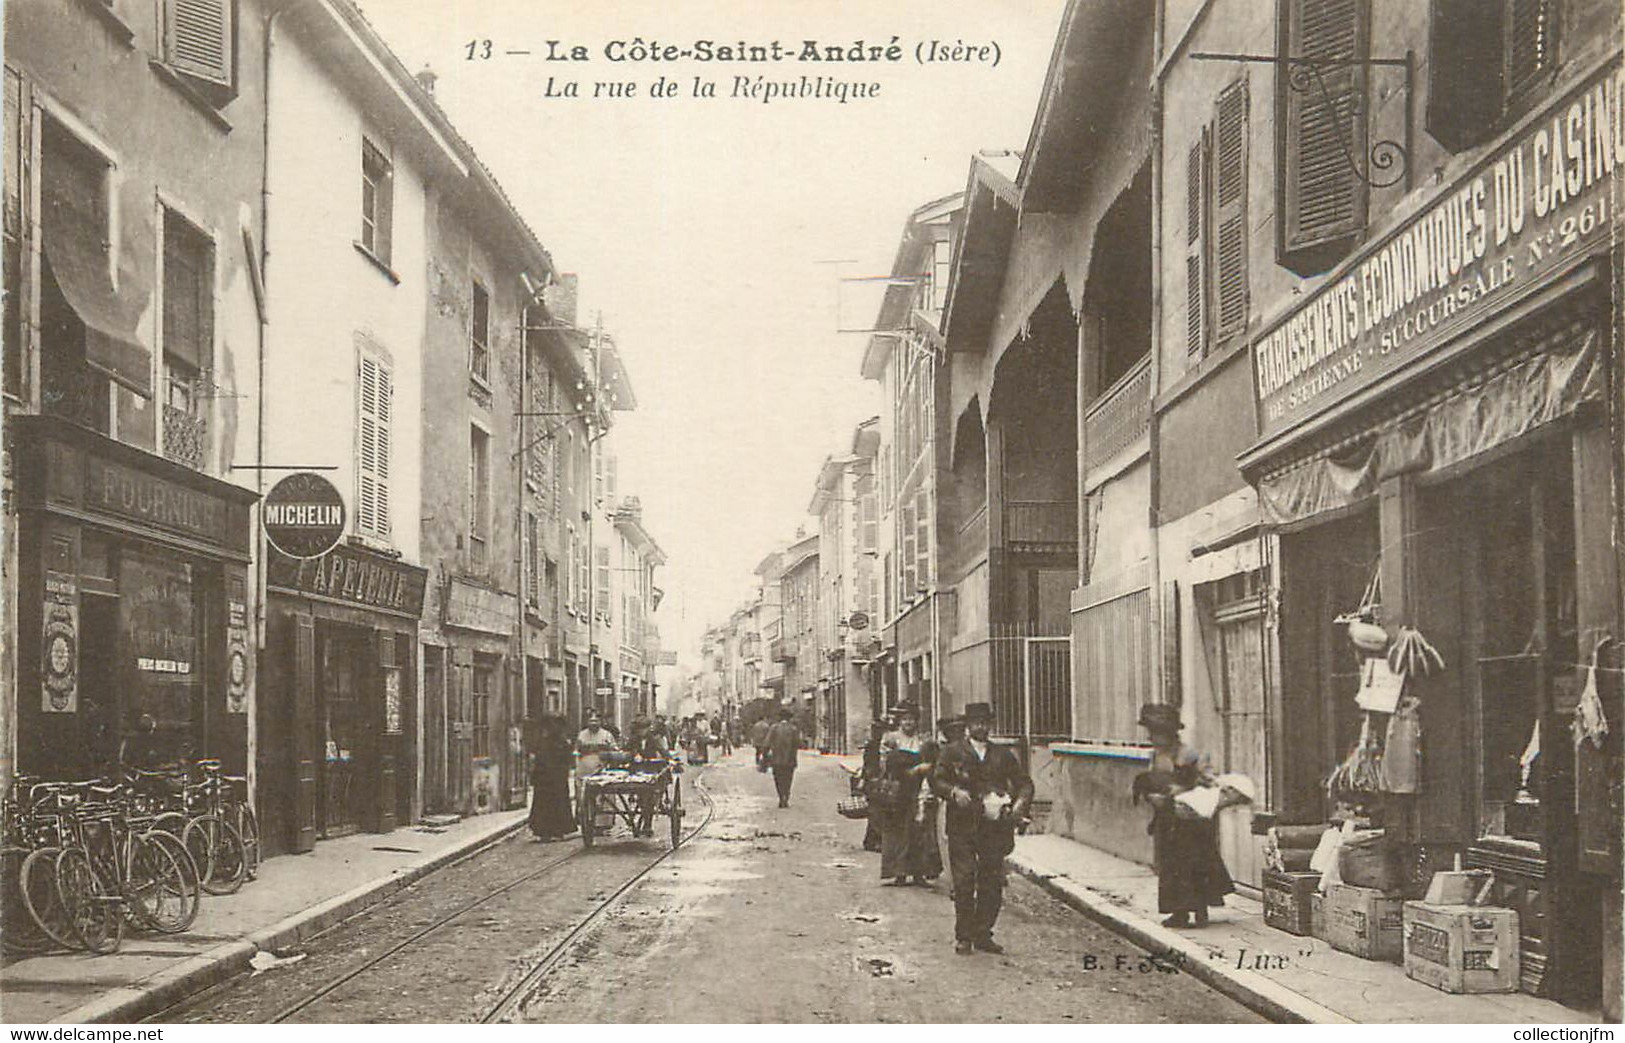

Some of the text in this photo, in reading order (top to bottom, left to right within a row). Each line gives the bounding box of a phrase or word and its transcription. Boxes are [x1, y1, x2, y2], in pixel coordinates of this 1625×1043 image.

[1362, 178, 1486, 330] ECONOMIQUES
[1495, 145, 1524, 247] DU
[1534, 65, 1625, 217] CASINO
[1381, 254, 1515, 355] SUCCURSALE
[1559, 197, 1606, 248] 261
[266, 505, 342, 525] MICHELIN
